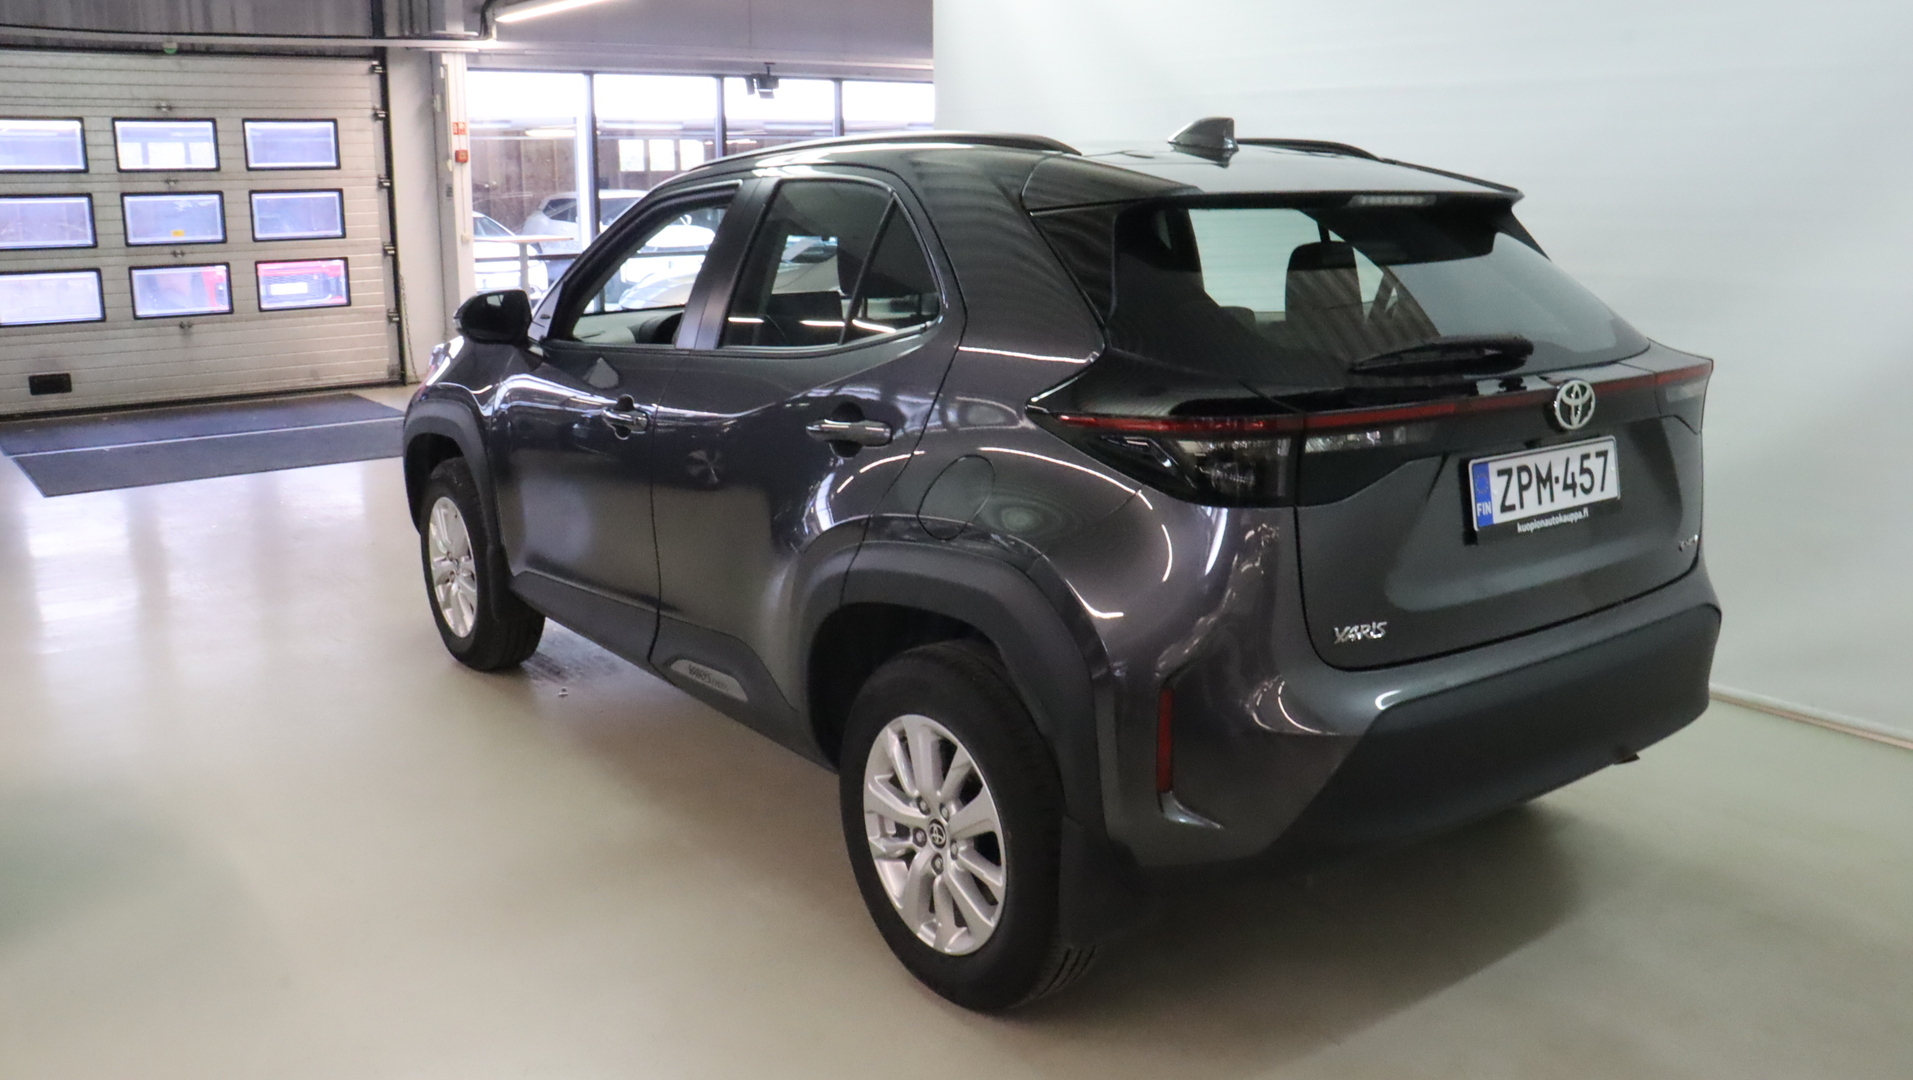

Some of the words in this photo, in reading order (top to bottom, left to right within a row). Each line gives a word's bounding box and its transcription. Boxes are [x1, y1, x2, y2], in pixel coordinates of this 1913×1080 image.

[1477, 502, 1492, 517] FIN
[1517, 507, 1589, 533] kuopionautokauppa.fi
[1333, 621, 1388, 645] YARIS
